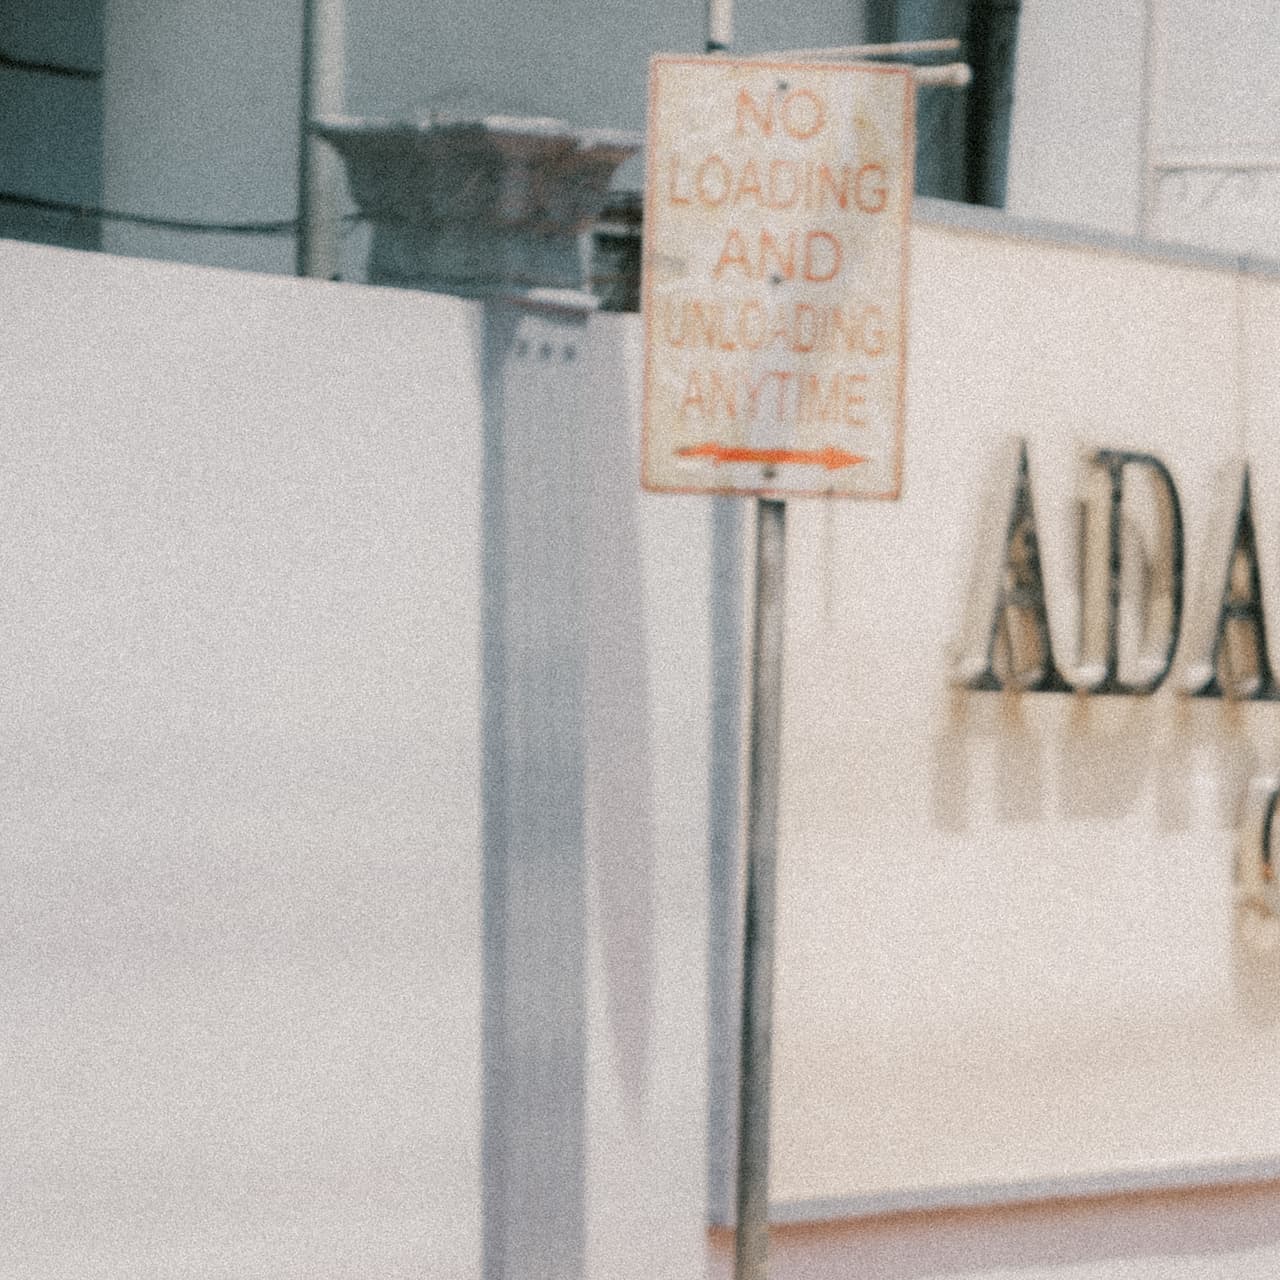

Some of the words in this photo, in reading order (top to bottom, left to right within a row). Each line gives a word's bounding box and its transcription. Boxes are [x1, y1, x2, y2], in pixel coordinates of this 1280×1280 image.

[735, 86, 828, 142] NO
[668, 153, 890, 216] LOADING
[713, 228, 843, 284] AND
[664, 297, 890, 358] UNLOADING
[678, 368, 869, 428] ANYTIME
